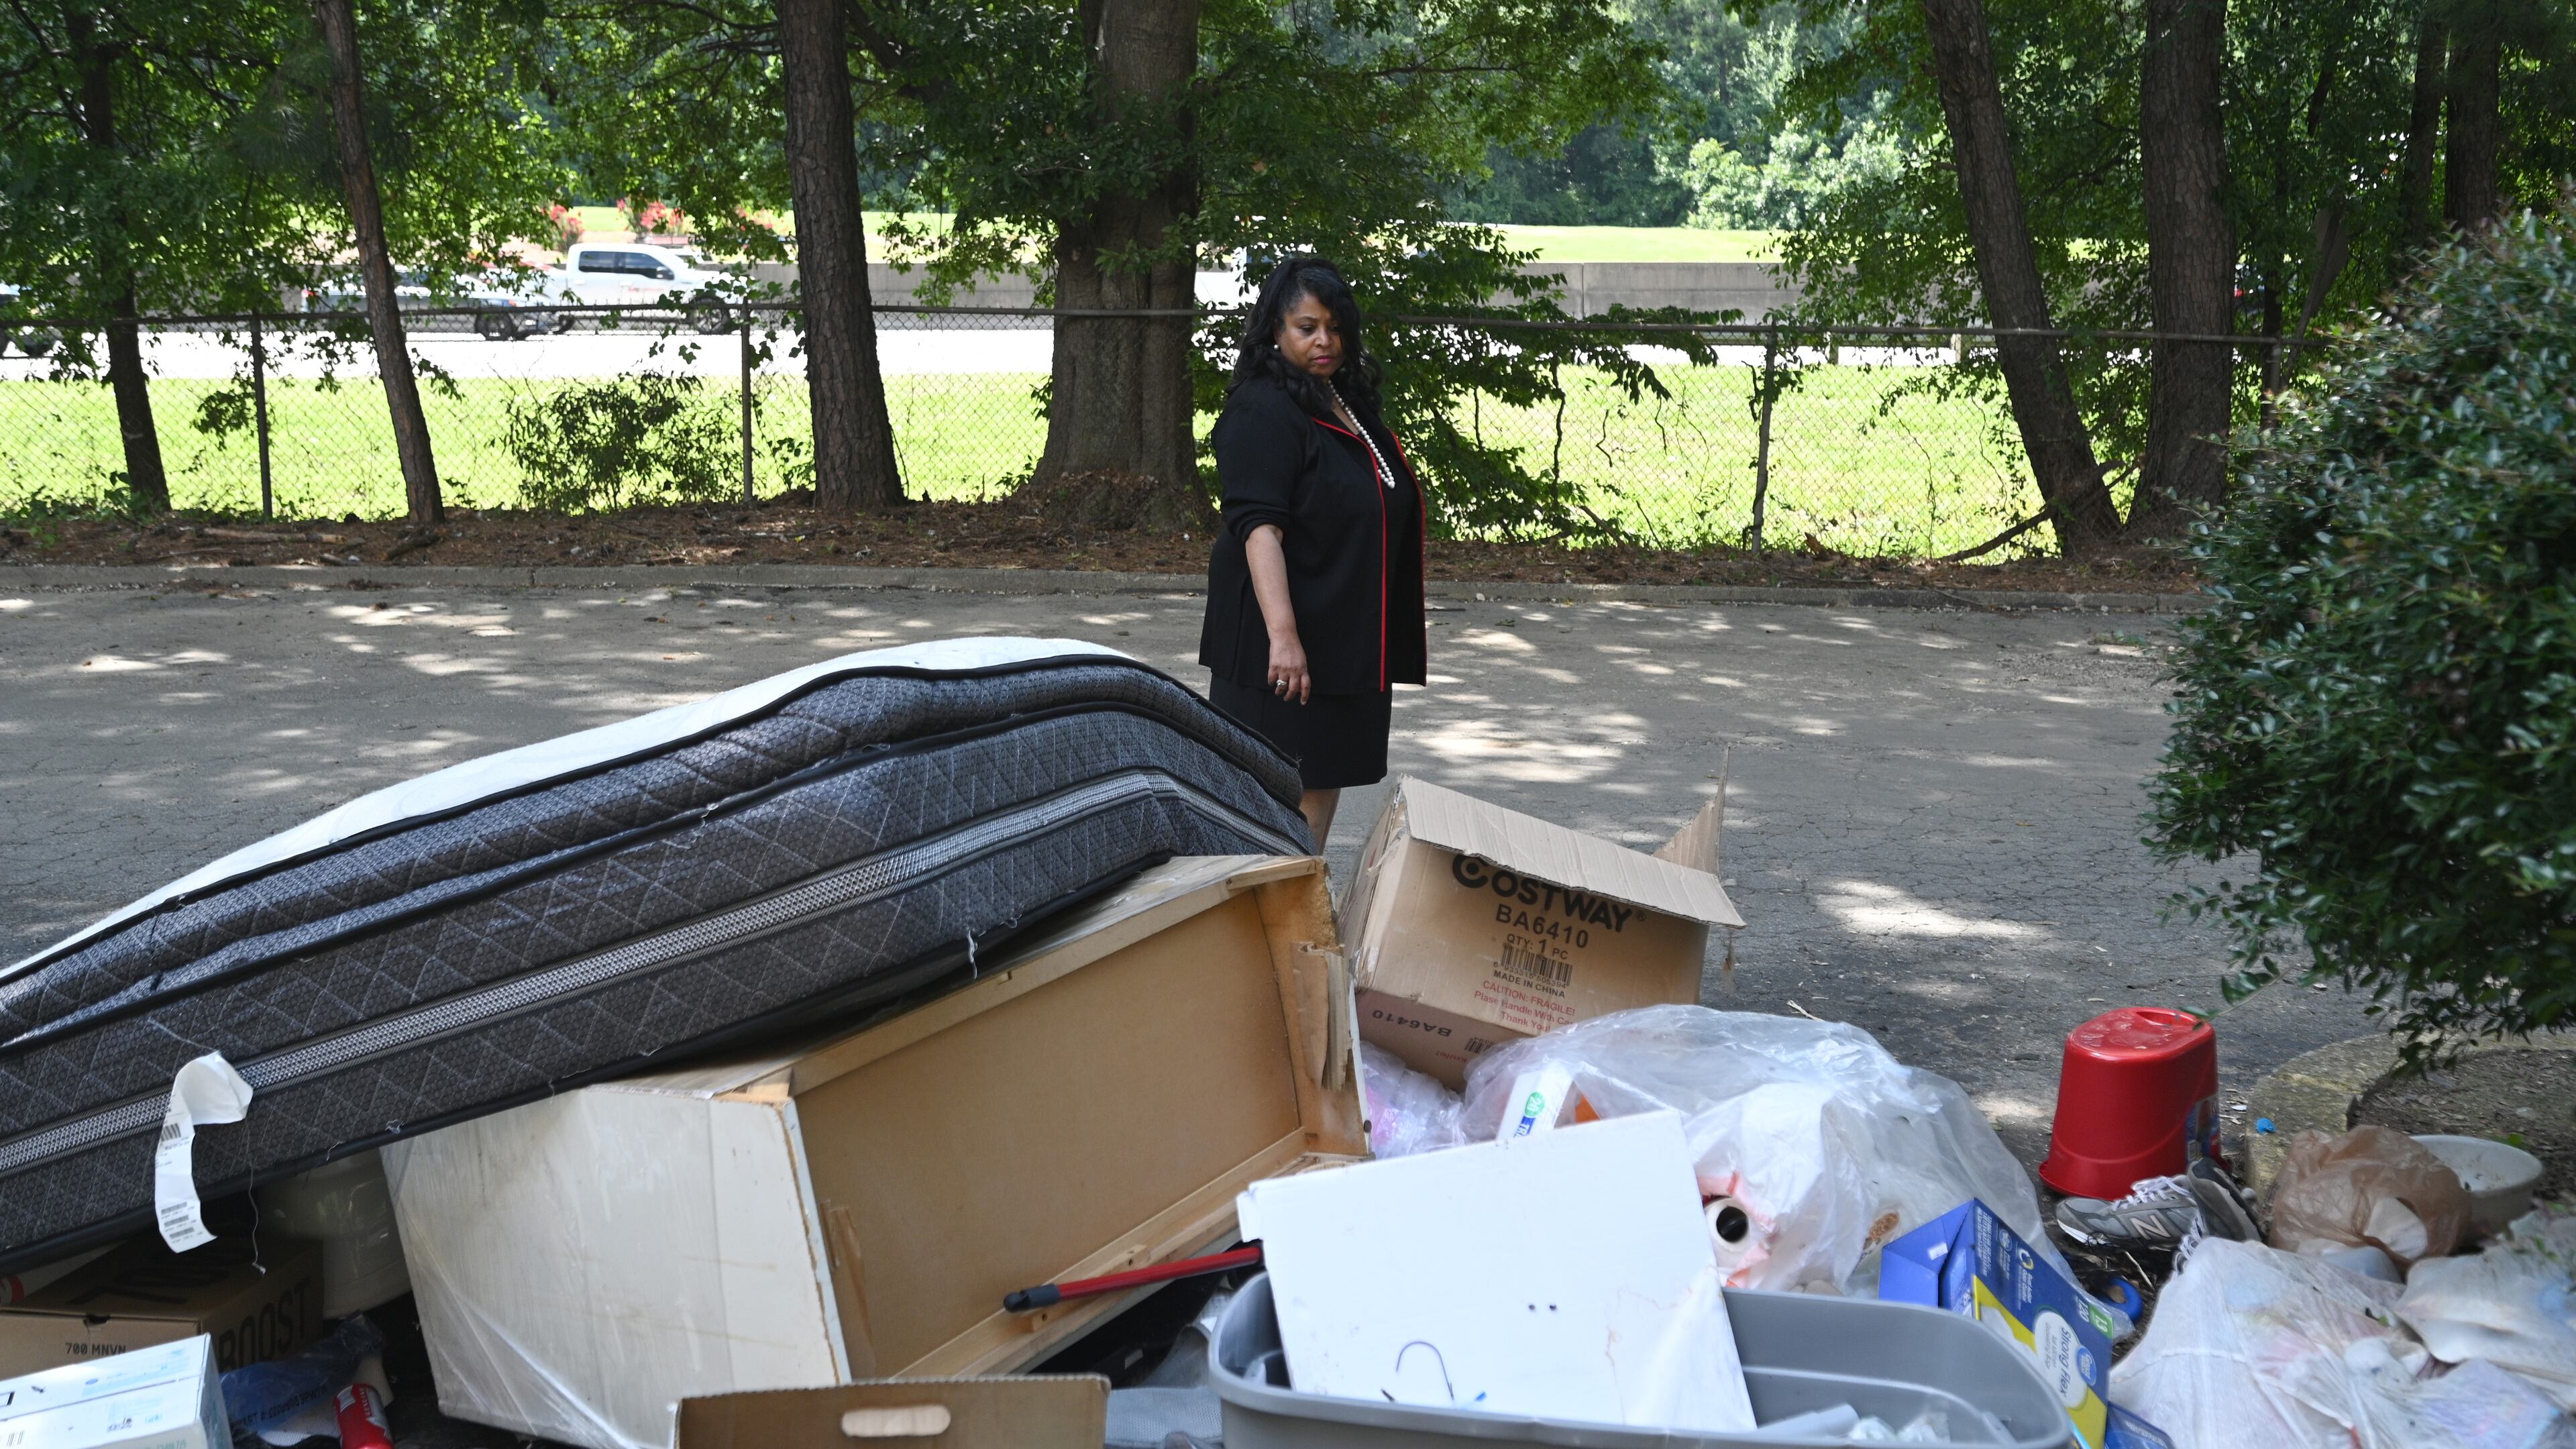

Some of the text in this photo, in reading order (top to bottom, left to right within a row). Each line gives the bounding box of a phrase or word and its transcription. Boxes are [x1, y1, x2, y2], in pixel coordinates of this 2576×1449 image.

[1452, 853, 1633, 932] COSTWAY
[1495, 904, 1589, 949] BA6410
[1507, 933, 1568, 960] QTY: 1 PC
[1493, 970, 1566, 998] MADE IN CHINA
[1474, 989, 1499, 1005] Plase
[1501, 999, 1533, 1016] Handle
[1535, 1010, 1555, 1022] With
[1483, 980, 1576, 1016] CAUTION: FRAGILE!
[1373, 1010, 1452, 1037] BA6410
[1501, 1011, 1551, 1032] Thank You!
[2129, 1214, 2172, 1240] N
[218, 1277, 312, 1370] BOOST
[2078, 1299, 2090, 1322] 120
[2095, 1315, 2108, 1332] 13
[66, 1342, 126, 1355] 700 MNVN
[2059, 1327, 2072, 1397] Strong Flex
